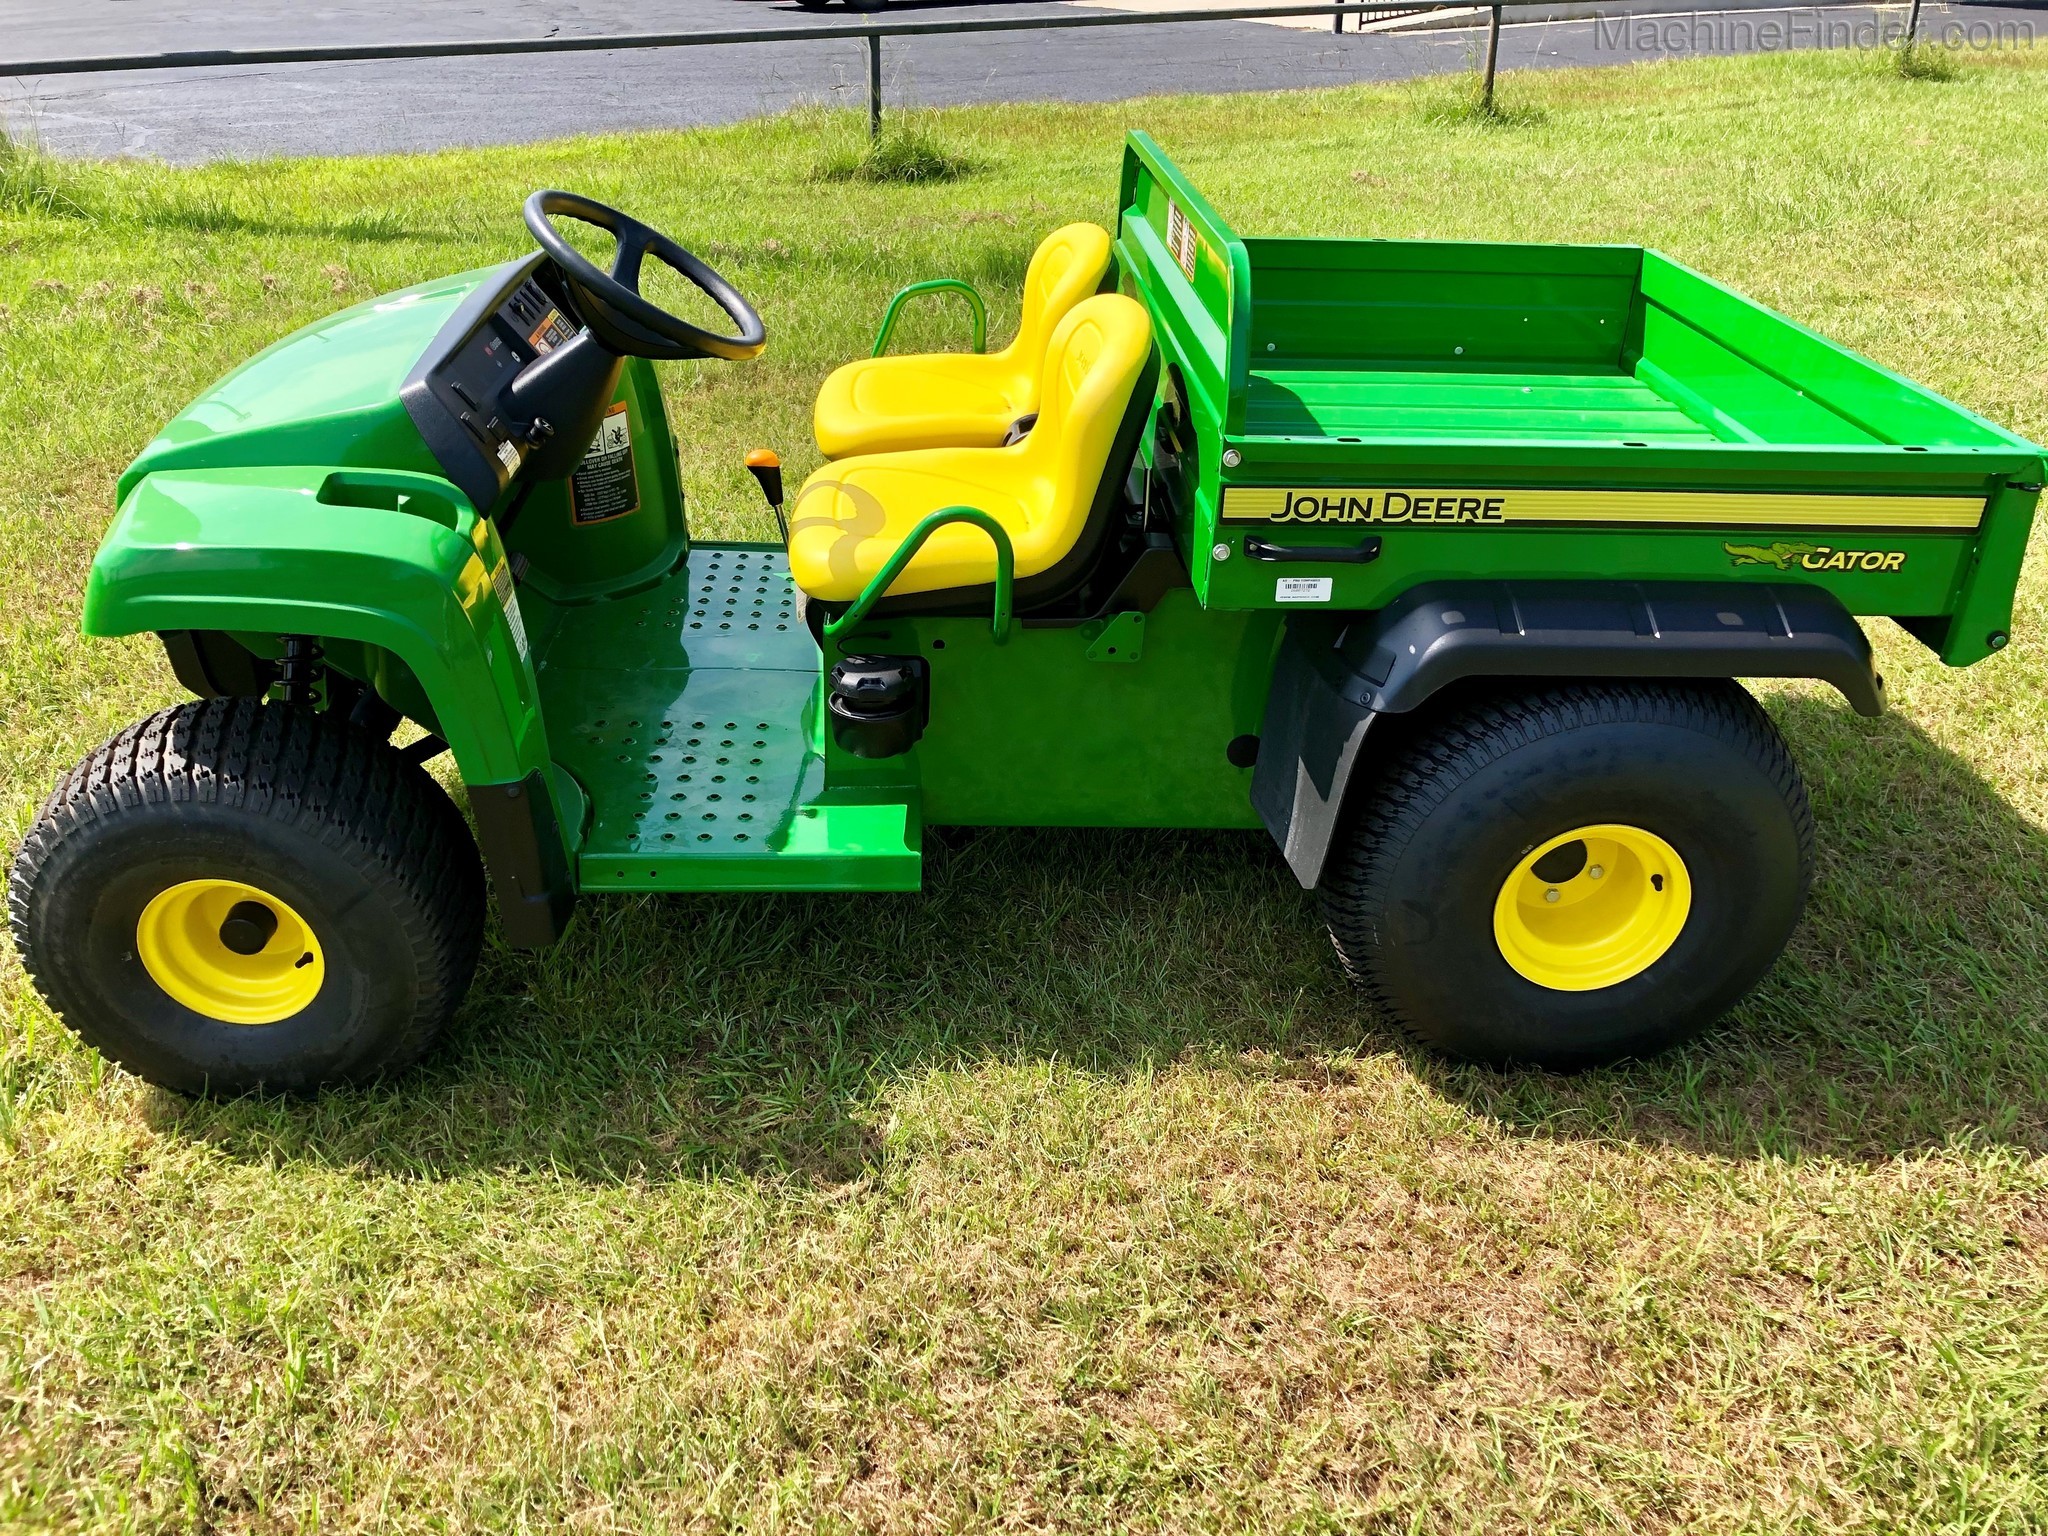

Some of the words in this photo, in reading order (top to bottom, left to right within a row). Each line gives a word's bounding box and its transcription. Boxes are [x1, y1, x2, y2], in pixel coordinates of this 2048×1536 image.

[580, 456, 601, 466] OLLOVER
[1270, 491, 1374, 519] JOHN
[1382, 492, 1505, 520] DEERE
[1801, 547, 1906, 571] GATOR
